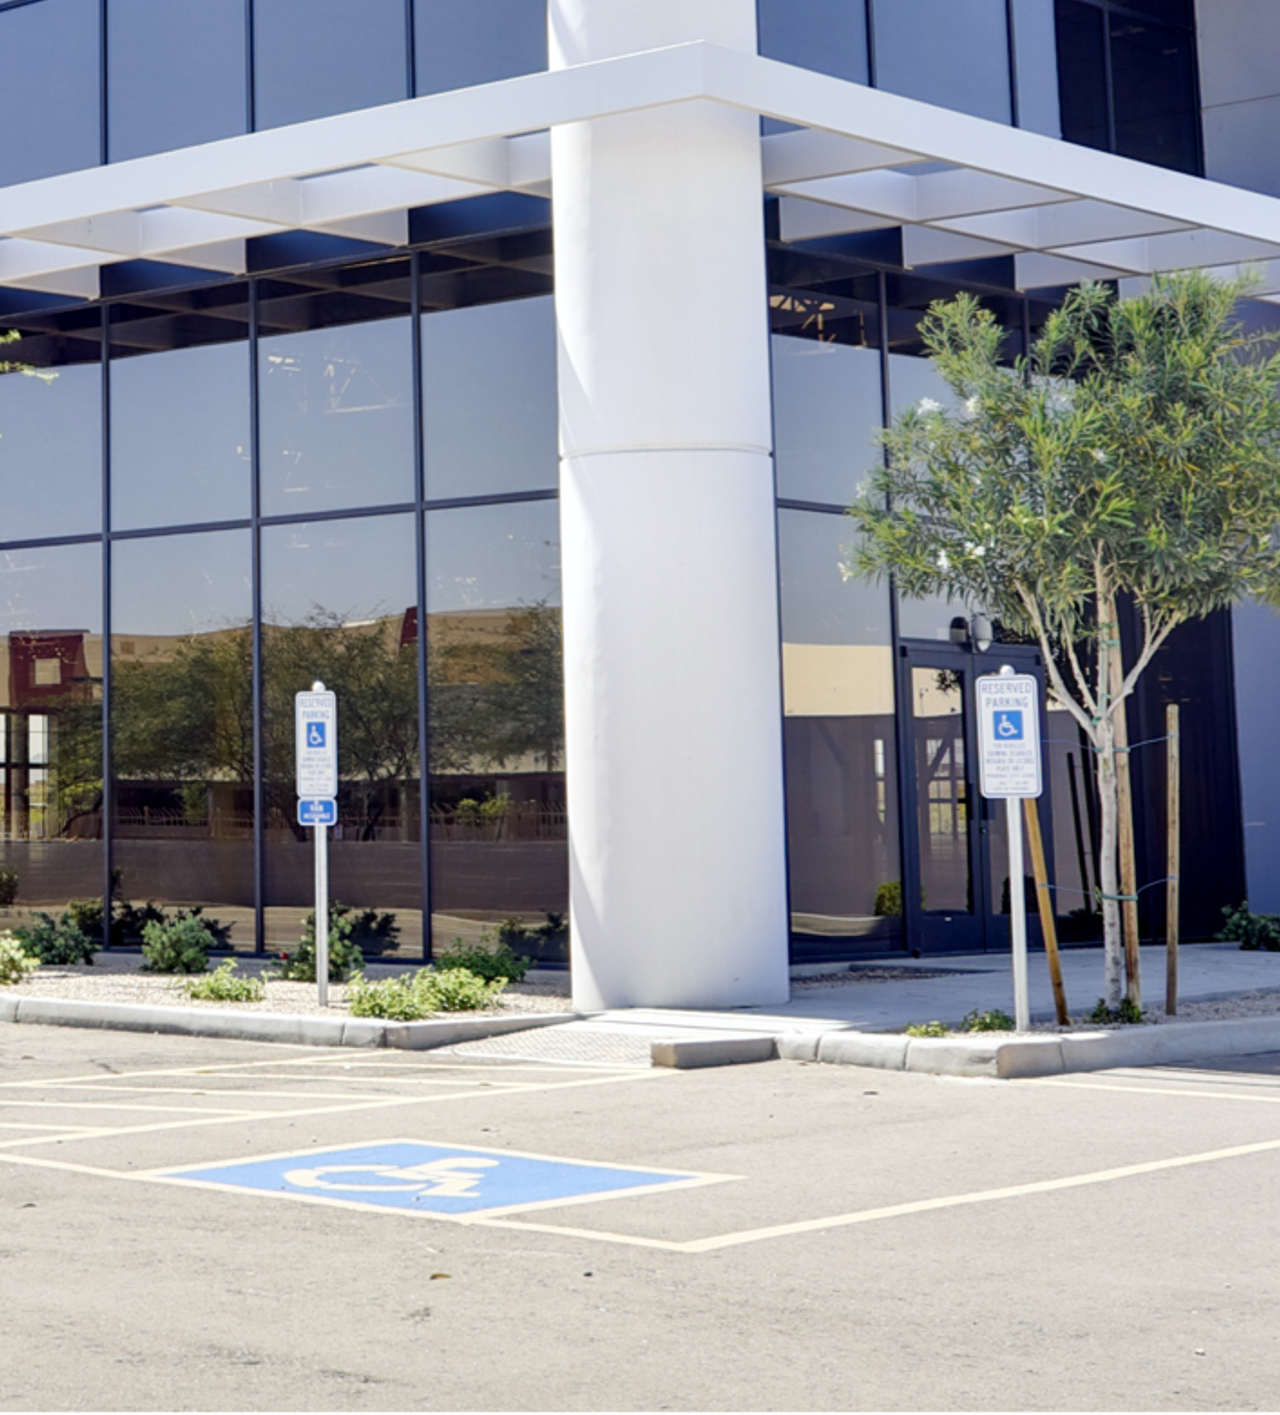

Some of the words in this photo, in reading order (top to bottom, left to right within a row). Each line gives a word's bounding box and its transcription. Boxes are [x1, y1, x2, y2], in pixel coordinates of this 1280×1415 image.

[981, 682, 1032, 695] RESERVED
[985, 696, 1029, 708] PARKING
[302, 709, 330, 720] PARKING
